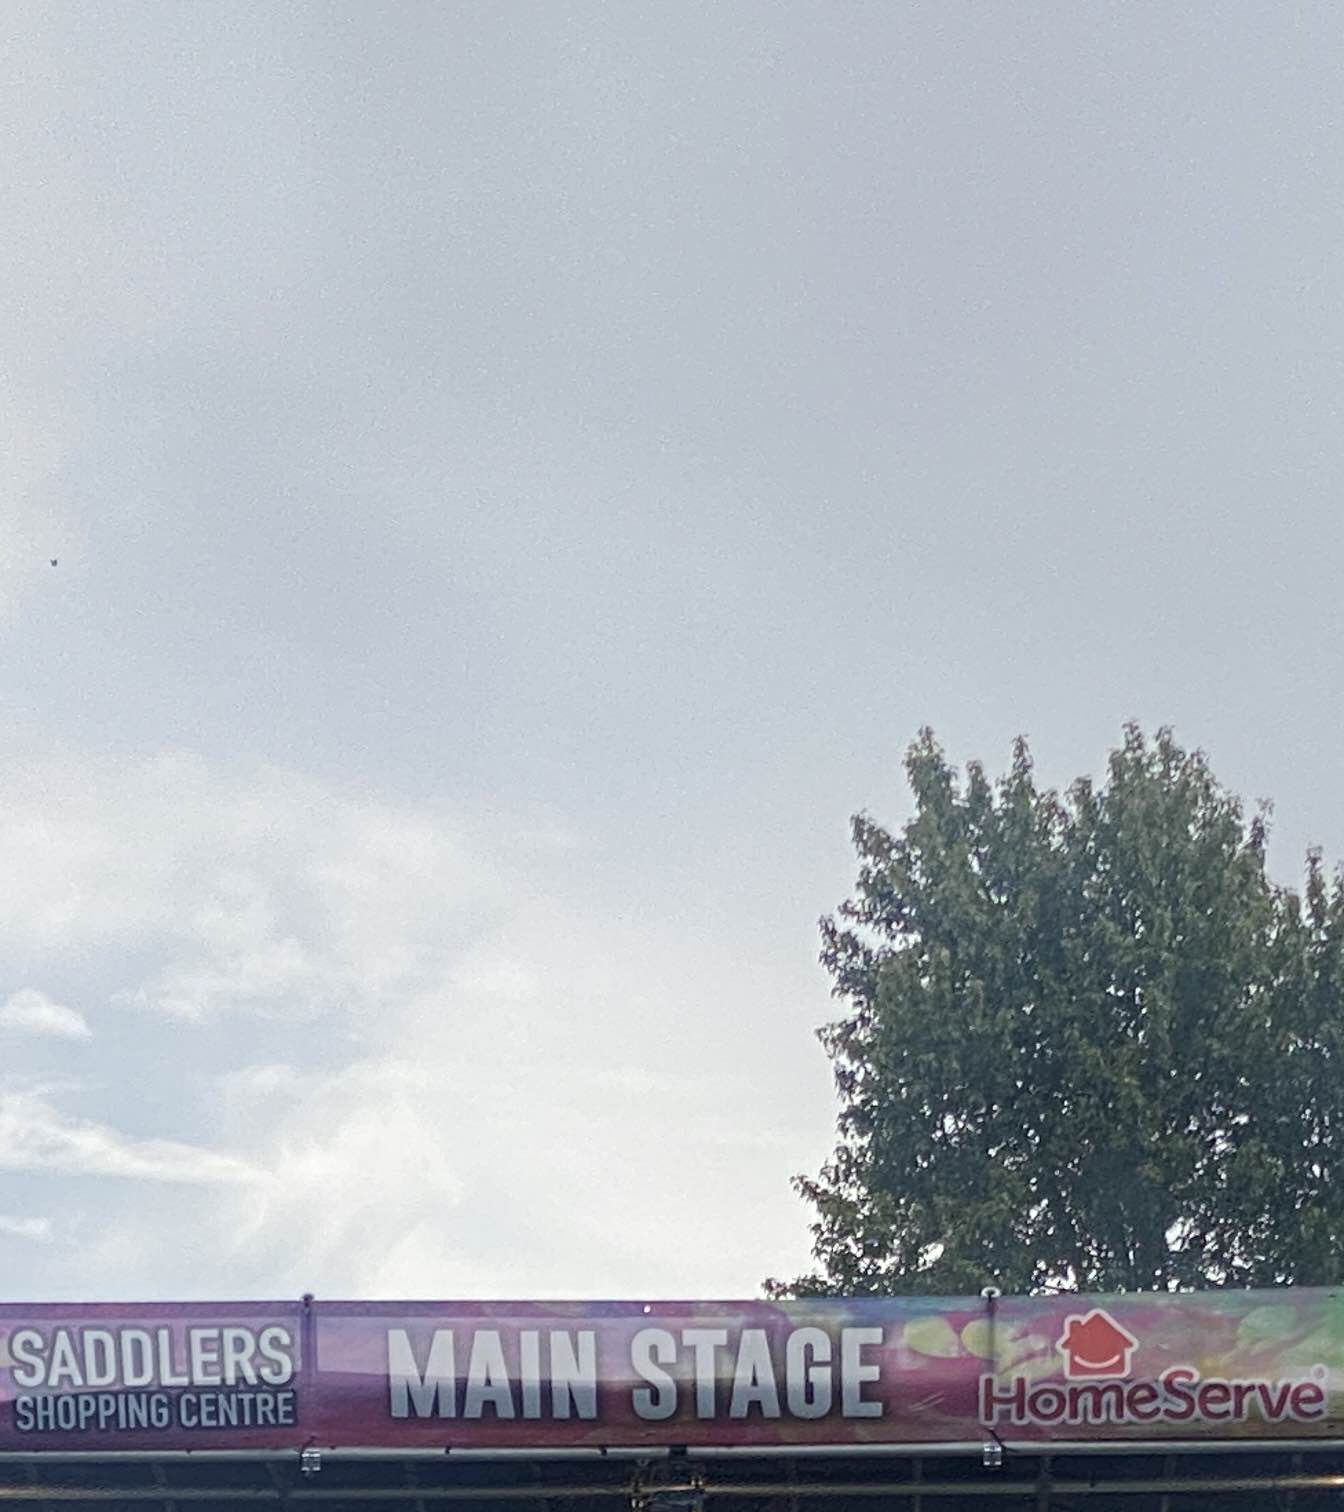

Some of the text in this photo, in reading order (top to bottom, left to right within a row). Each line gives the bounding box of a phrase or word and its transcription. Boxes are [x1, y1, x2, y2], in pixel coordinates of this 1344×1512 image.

[10, 1328, 293, 1387] SADDLERS
[388, 1326, 884, 1419] MAIN STAGE
[14, 1391, 294, 1431] SHOPPING CENTRE
[982, 1367, 1324, 1423] HomeServe
